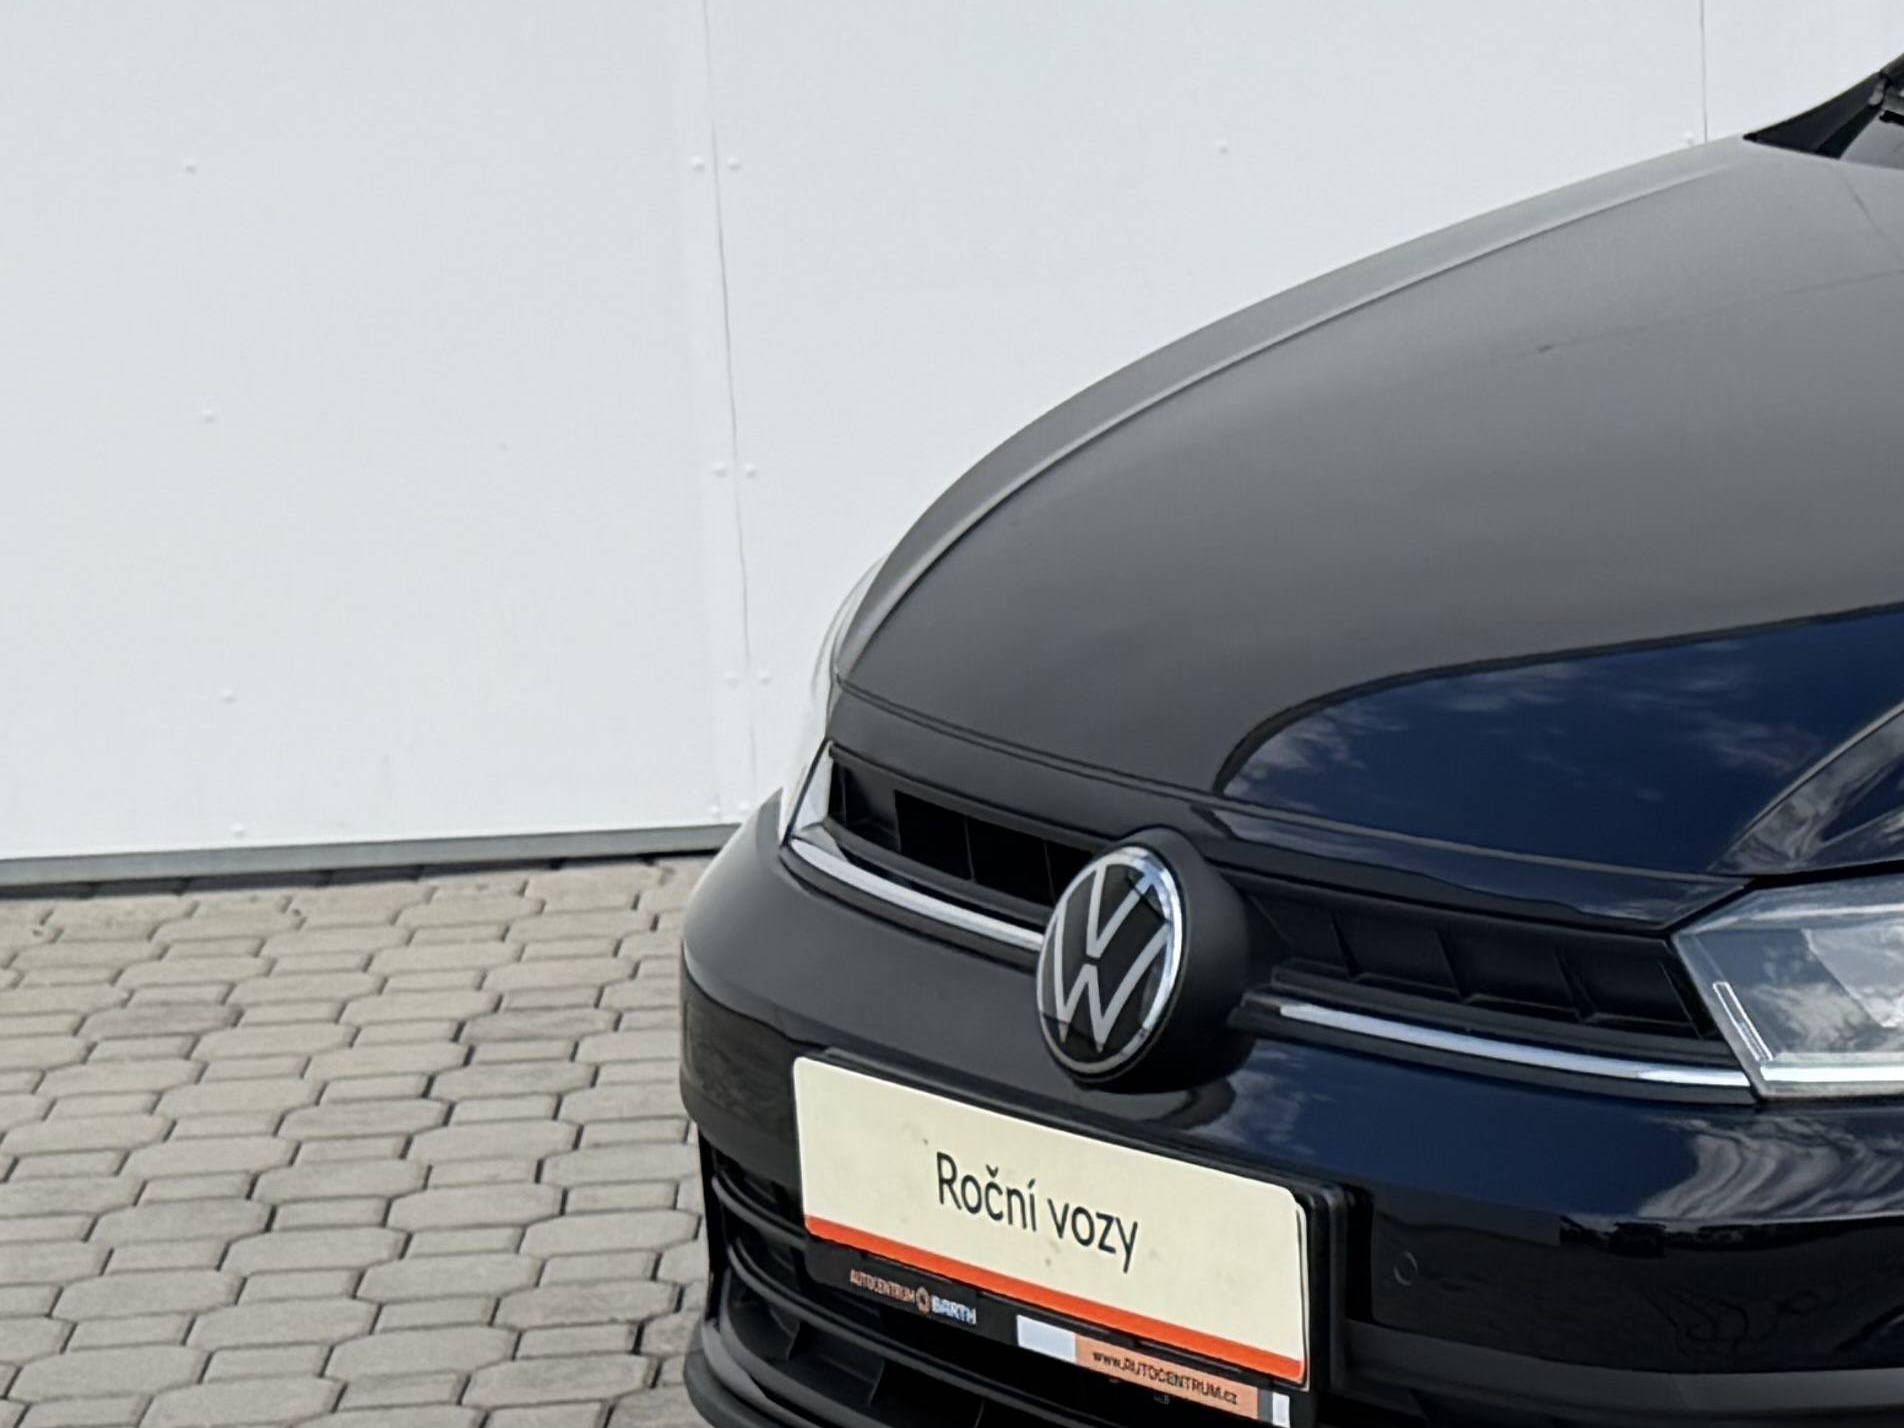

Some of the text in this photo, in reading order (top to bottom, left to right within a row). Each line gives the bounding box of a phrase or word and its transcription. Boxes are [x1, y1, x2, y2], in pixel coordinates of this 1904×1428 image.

[936, 1151, 1139, 1273] Roční vozy
[849, 1268, 977, 1325] AUTOCENTRUM BARTH
